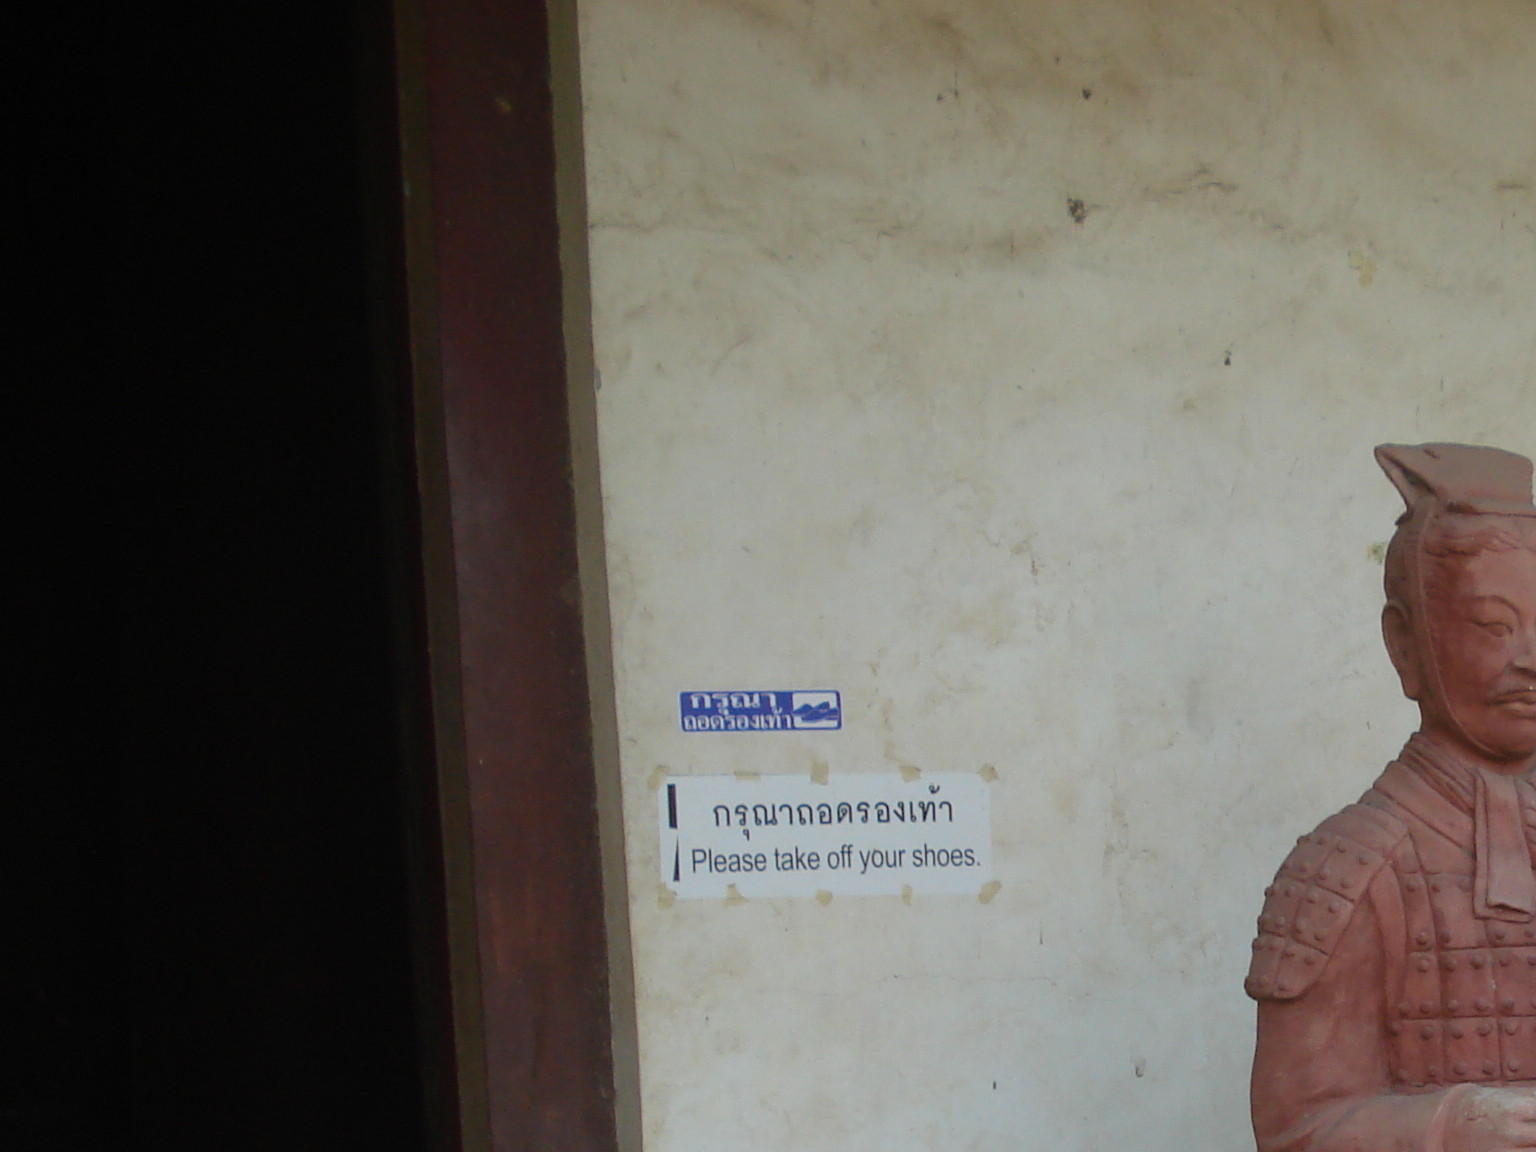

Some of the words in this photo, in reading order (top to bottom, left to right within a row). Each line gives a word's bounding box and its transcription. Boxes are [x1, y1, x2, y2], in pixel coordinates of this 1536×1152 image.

[690, 692, 777, 715] กรุณา
[683, 706, 793, 730] ถอดรองเท้า
[712, 785, 954, 840] กรุณาถอดรองเท้า
[691, 847, 767, 874] Please
[774, 846, 821, 872] take
[827, 844, 853, 869] off
[859, 847, 906, 875] your
[912, 842, 981, 868] shoes.
